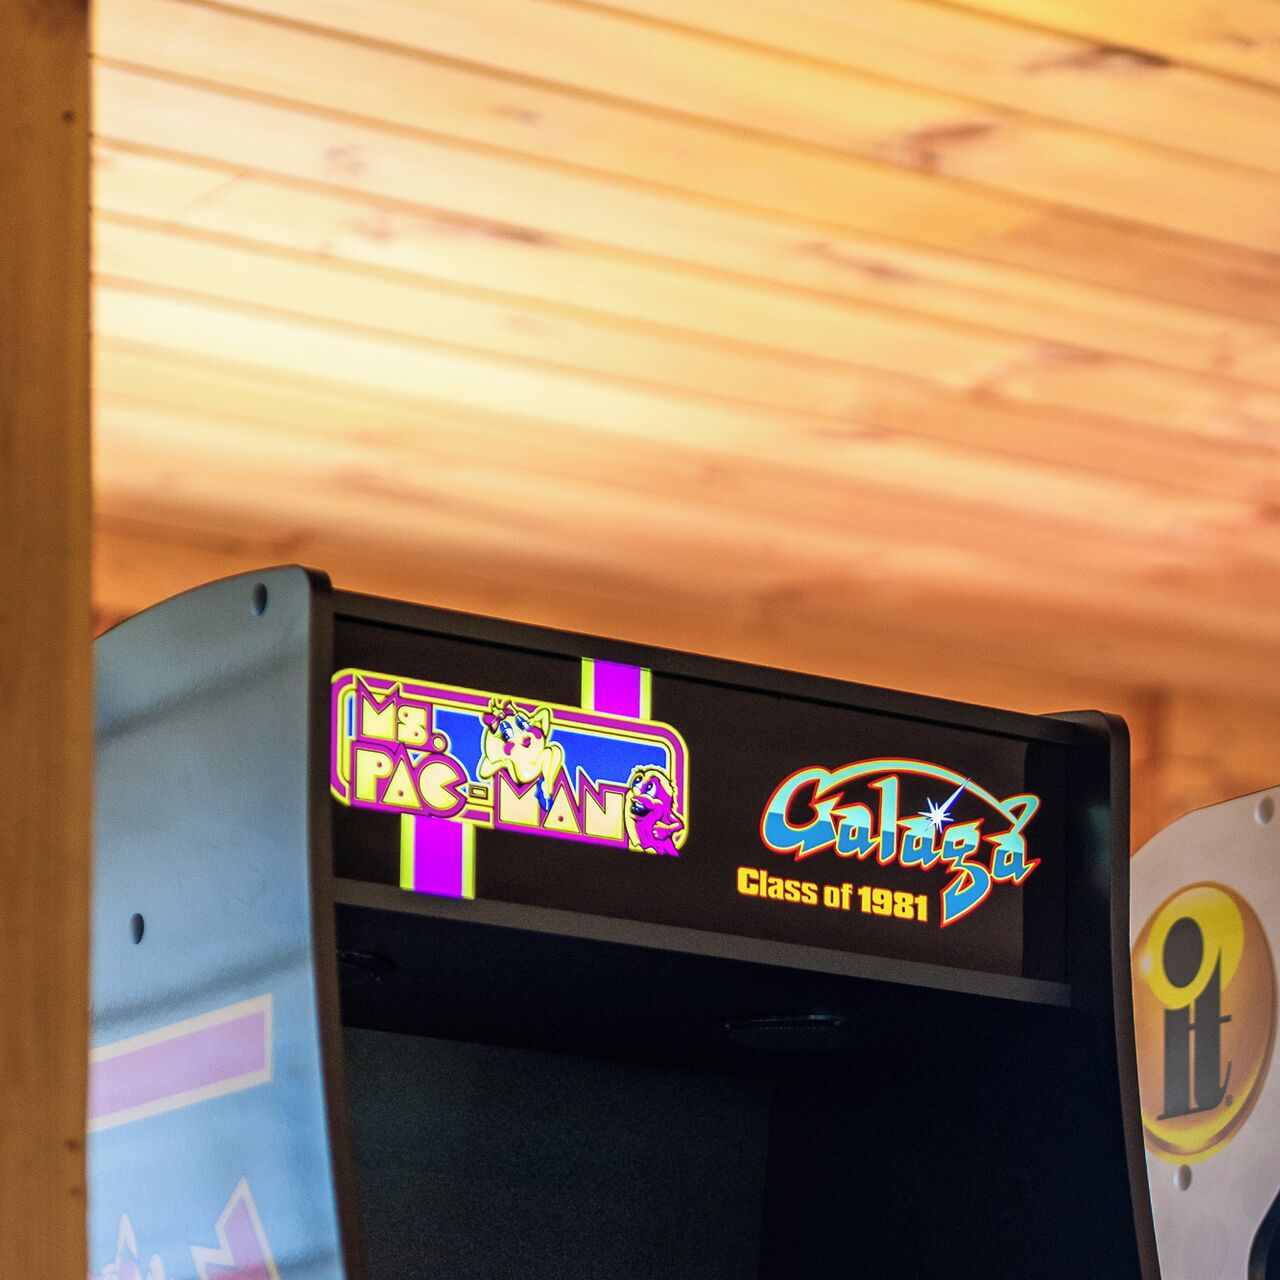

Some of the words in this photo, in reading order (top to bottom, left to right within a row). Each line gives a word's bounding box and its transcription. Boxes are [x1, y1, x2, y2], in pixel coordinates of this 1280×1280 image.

[356, 677, 449, 754] Ms.
[353, 742, 629, 847] PAC-MAN
[759, 756, 1041, 928] Galaga
[737, 866, 818, 905] Class
[823, 883, 853, 911] of
[857, 885, 928, 923] 1981
